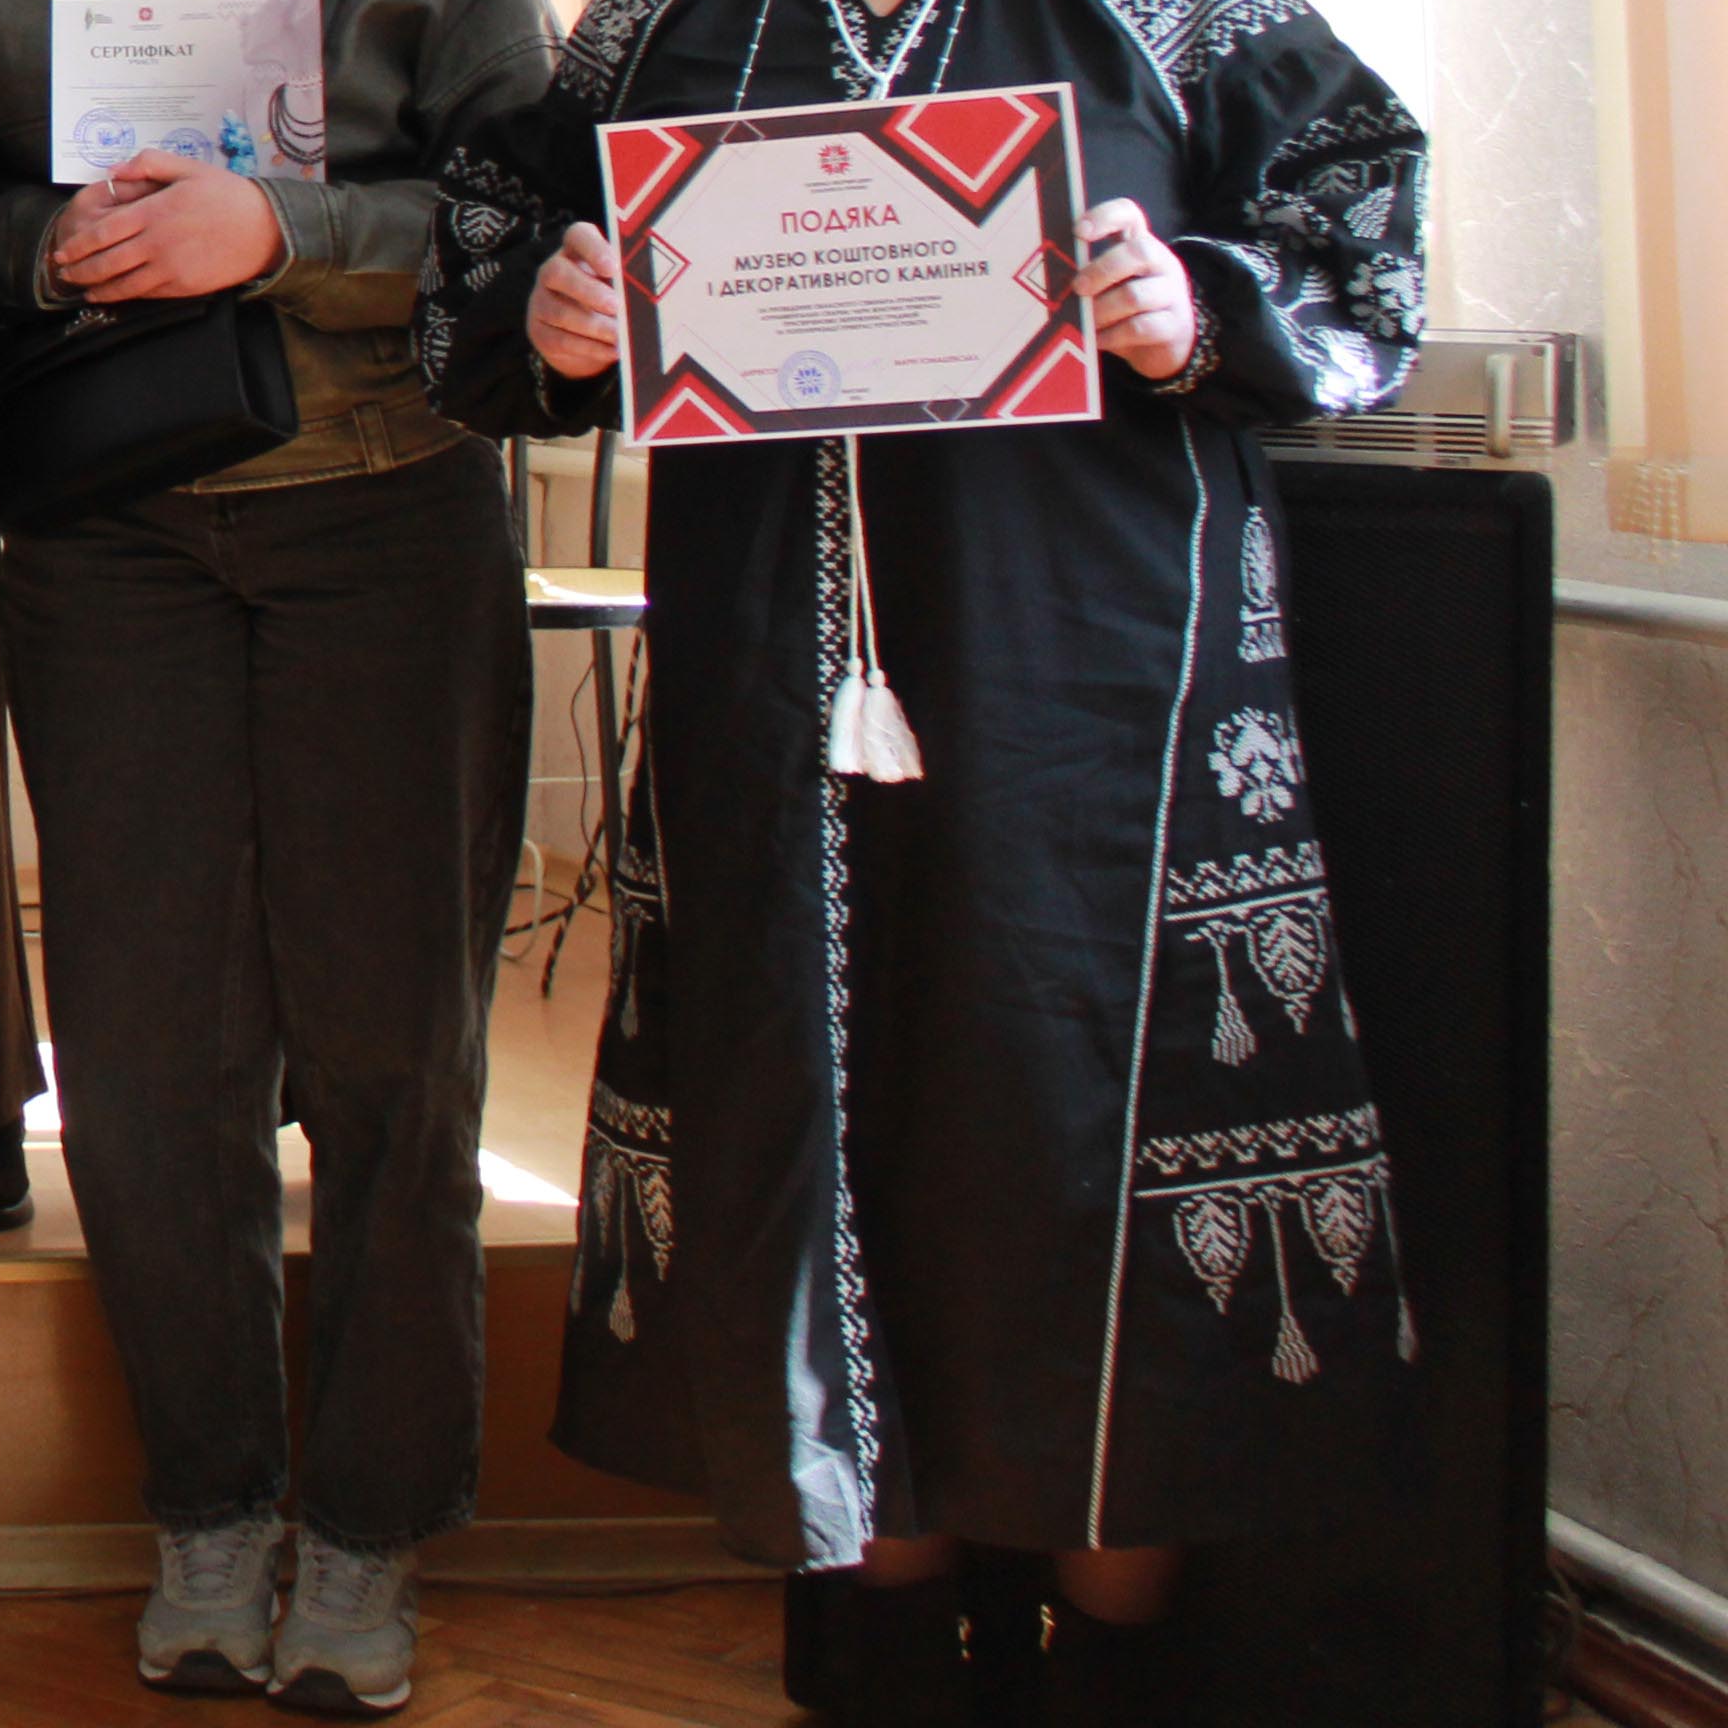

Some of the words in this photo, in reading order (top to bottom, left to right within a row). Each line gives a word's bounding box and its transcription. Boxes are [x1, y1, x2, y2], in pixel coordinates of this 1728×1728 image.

[90, 43, 195, 59] СЕРТИФІКАТ
[781, 204, 901, 234] ПОДЯКА
[734, 250, 807, 271] МУЗЕЮ
[815, 239, 957, 265] КОШТОВНОГО
[720, 267, 891, 297] ДЕКОРАТИВНОГО
[898, 260, 990, 282] КАМІННЯ
